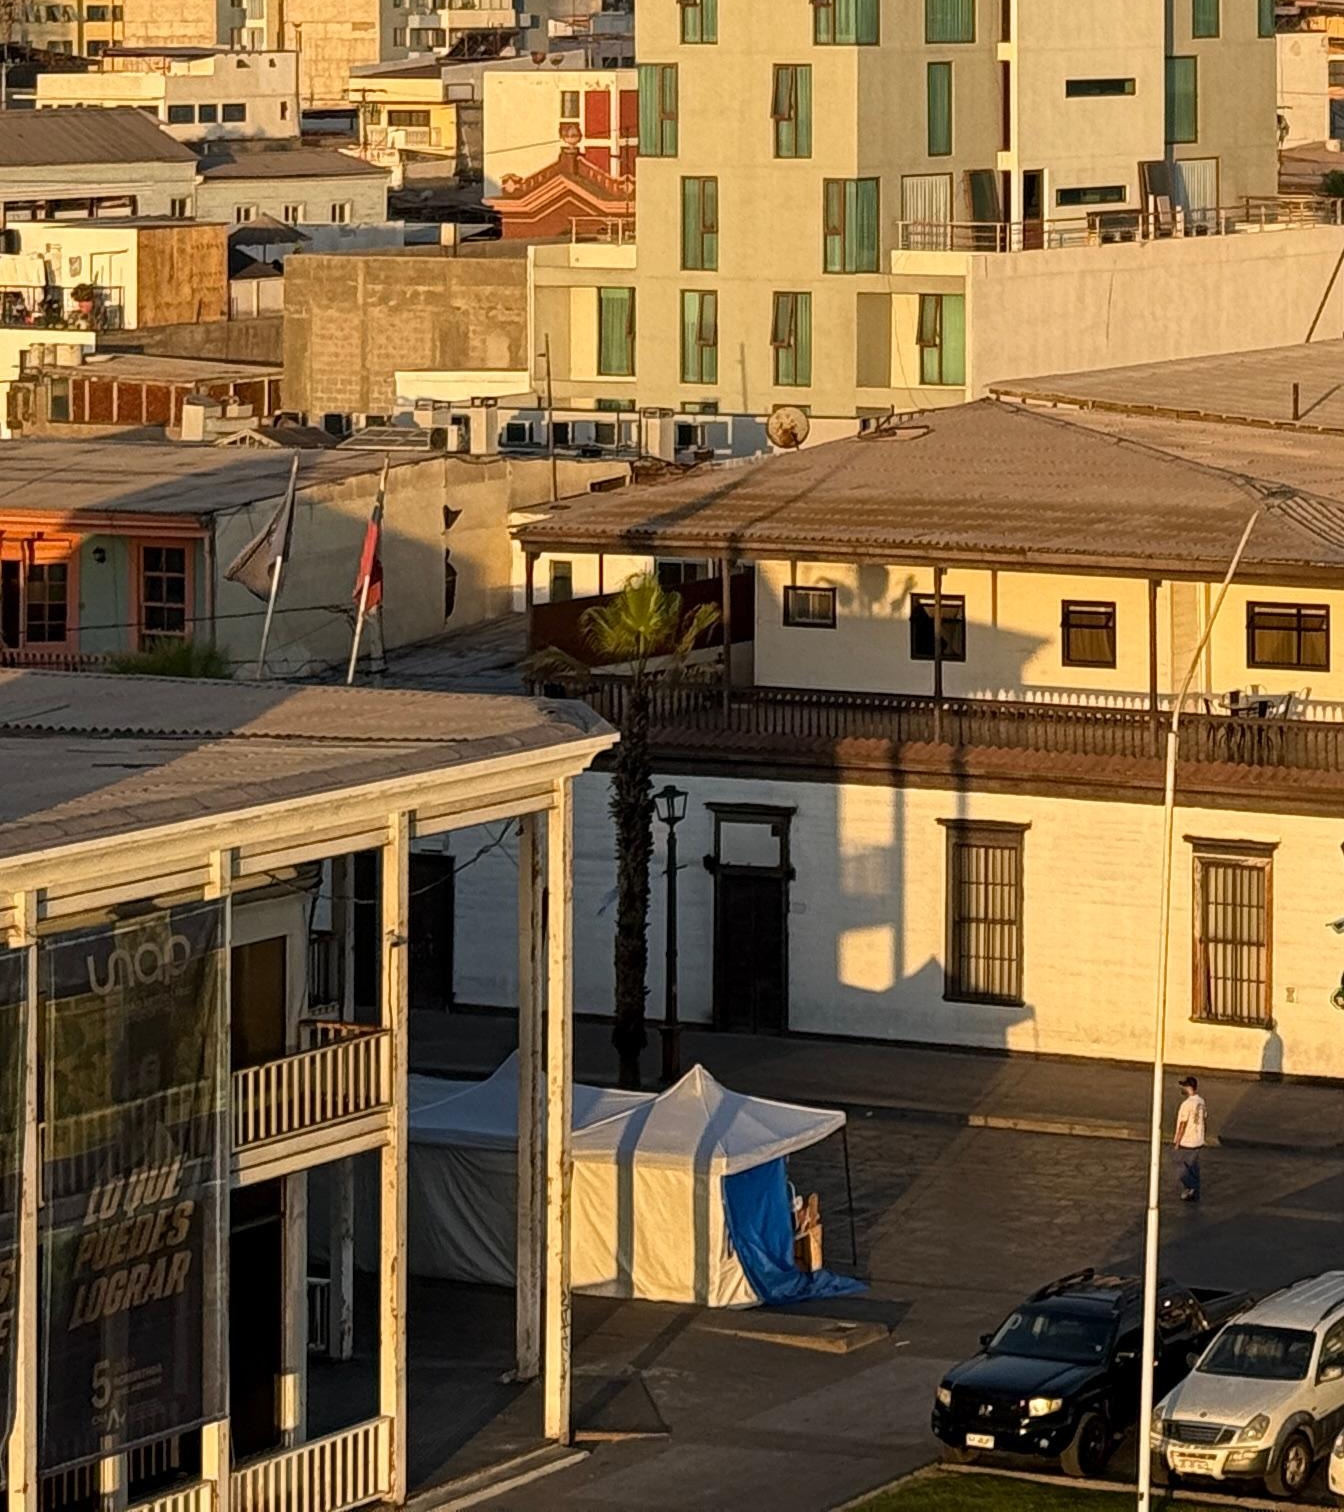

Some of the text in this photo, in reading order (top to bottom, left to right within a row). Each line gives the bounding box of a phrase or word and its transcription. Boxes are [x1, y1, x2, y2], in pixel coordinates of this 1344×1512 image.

[74, 1199, 194, 1279] PUEDES
[83, 1179, 125, 1226] LO
[67, 1249, 193, 1331] LOGRAR
